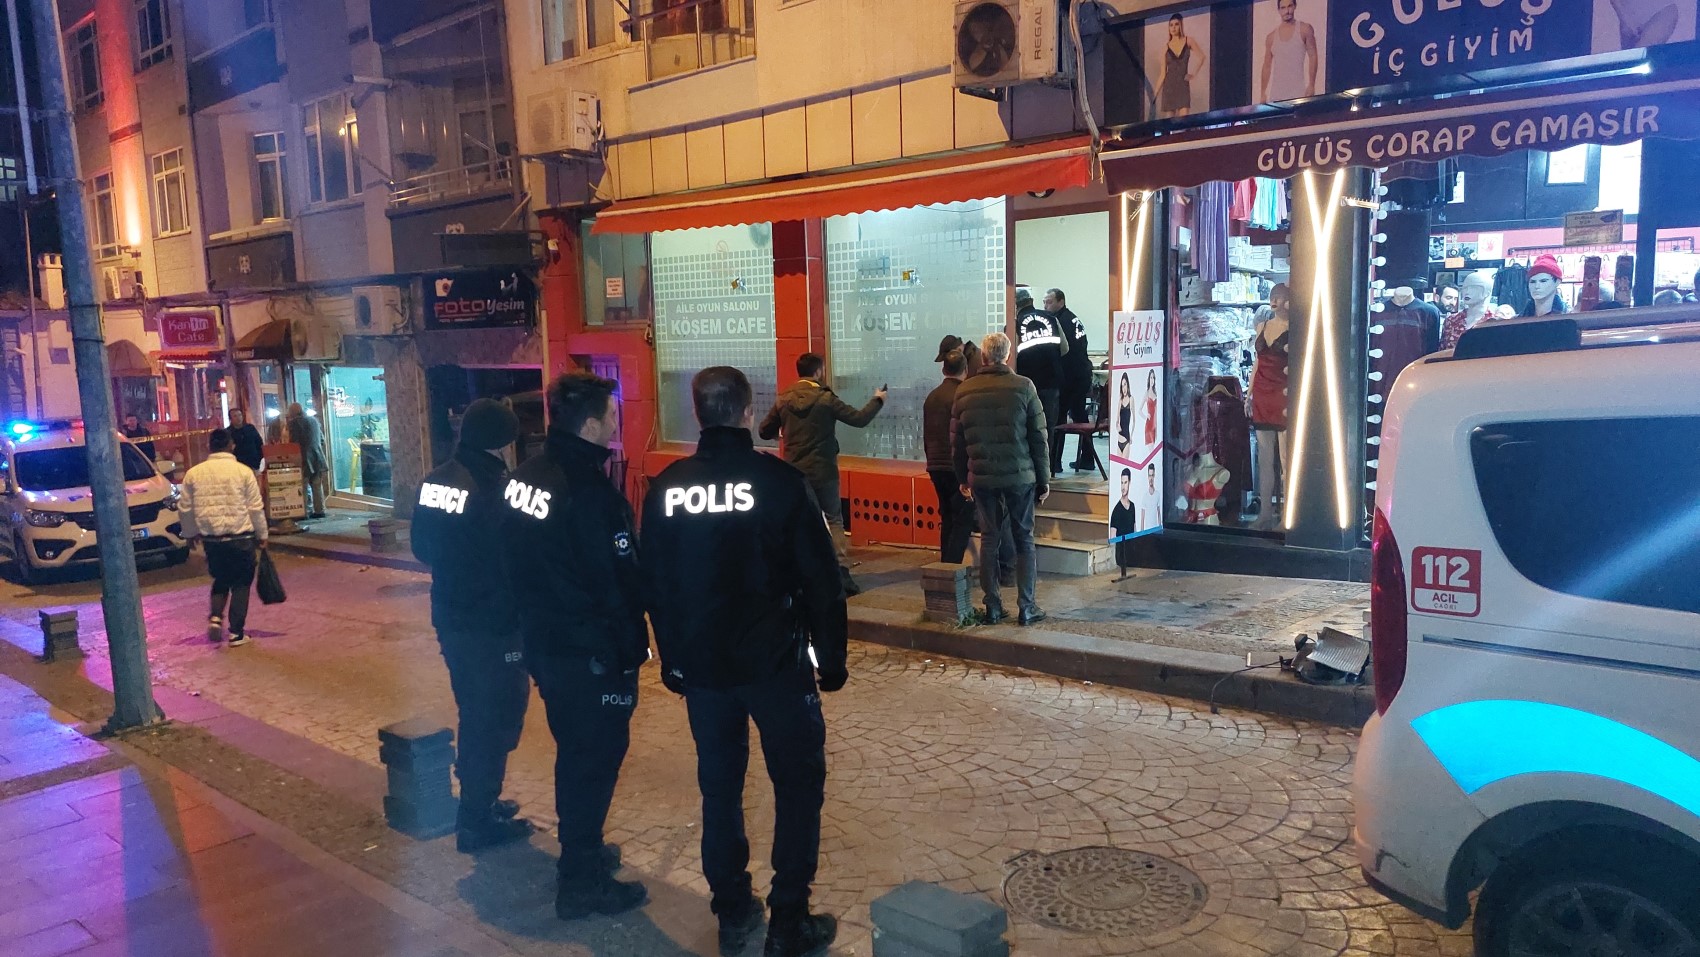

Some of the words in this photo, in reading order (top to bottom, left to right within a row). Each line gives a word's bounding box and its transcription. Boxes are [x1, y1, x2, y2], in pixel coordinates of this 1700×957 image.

[1034, 7, 1043, 60] REGAL
[1372, 46, 1405, 77] İÇ
[1420, 27, 1533, 67] GİYİM
[1366, 124, 1476, 162] ÇORAP
[1490, 105, 1659, 150] ÇAMAŞIR
[696, 302, 720, 313] OYUN
[722, 300, 760, 312] SALONU
[671, 316, 722, 339] KÖŞEM
[726, 317, 768, 335] CAFE
[1116, 316, 1162, 346] GÜLÜŞ
[1133, 343, 1153, 358] Giyim
[1421, 554, 1470, 588] 112
